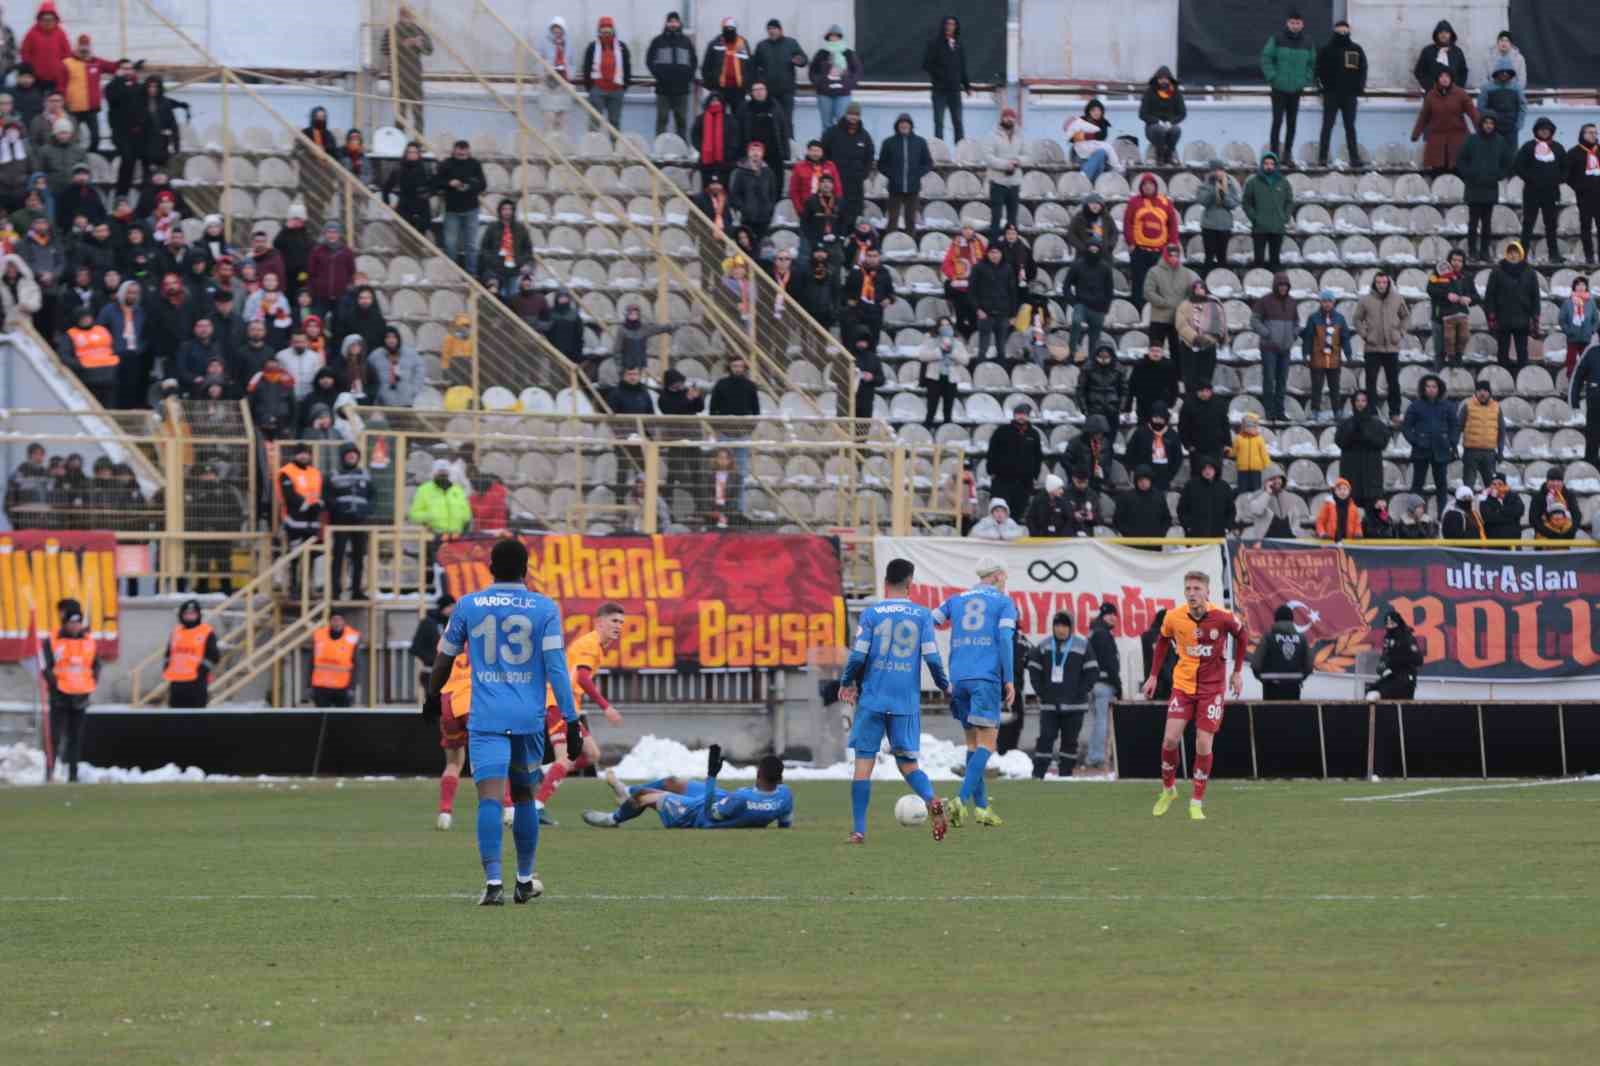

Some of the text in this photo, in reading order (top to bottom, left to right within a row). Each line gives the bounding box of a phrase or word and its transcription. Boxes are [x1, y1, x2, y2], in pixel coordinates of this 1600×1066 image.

[544, 534, 684, 599] Abant
[1446, 562, 1578, 593] ultrAslan
[698, 596, 846, 668] Baysal
[873, 618, 920, 658] 19
[961, 599, 987, 632] 8
[472, 614, 533, 665] 13
